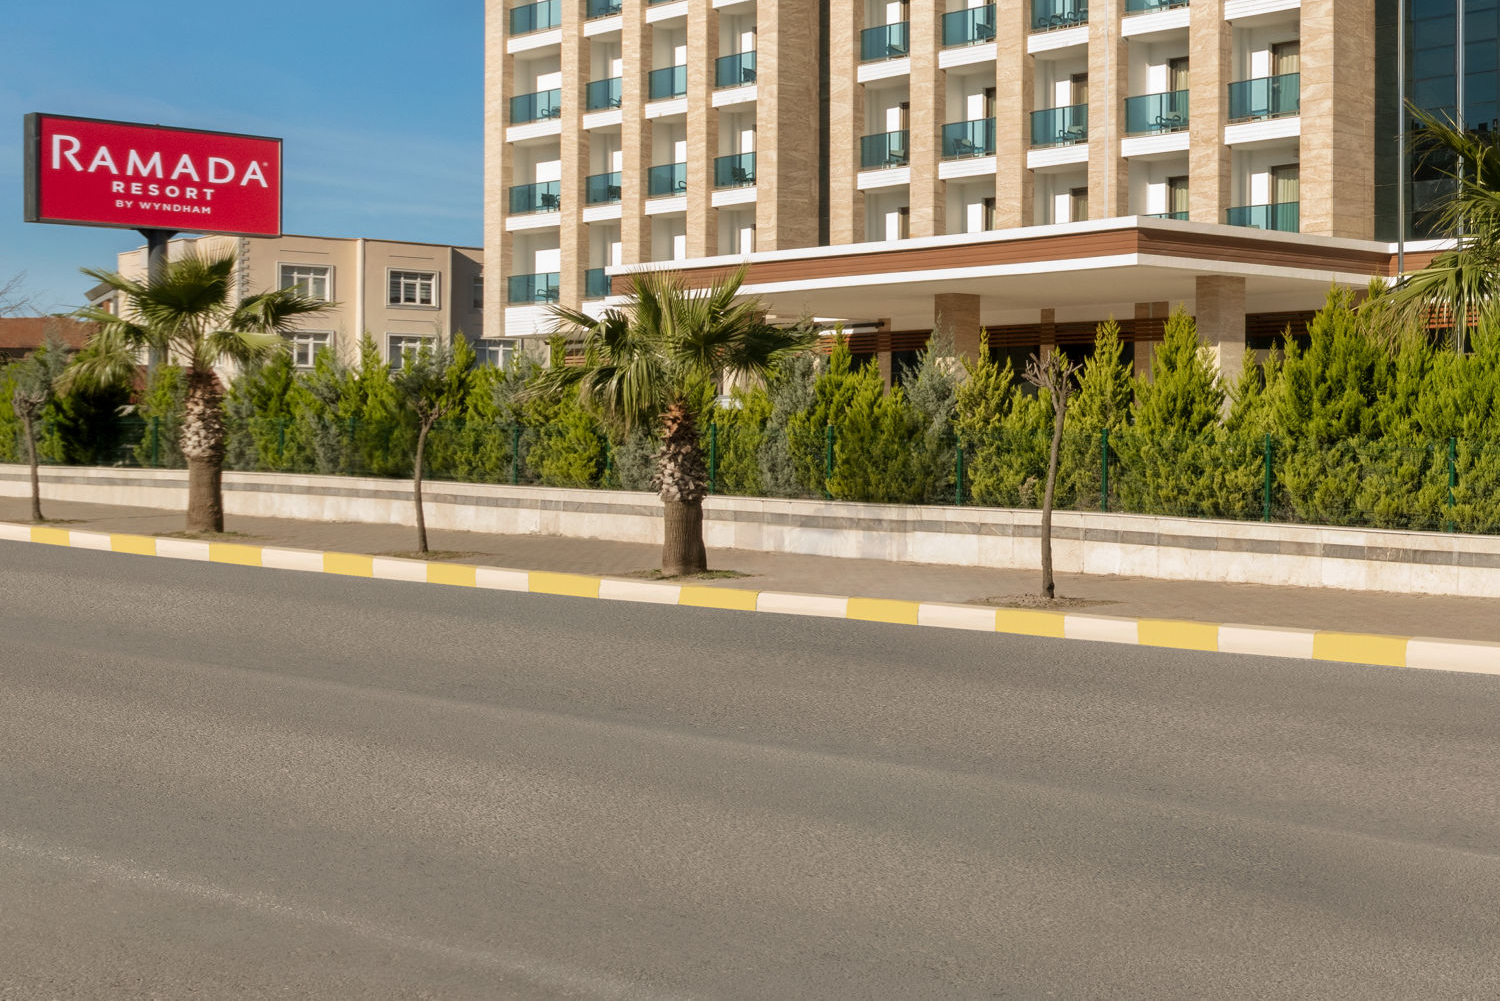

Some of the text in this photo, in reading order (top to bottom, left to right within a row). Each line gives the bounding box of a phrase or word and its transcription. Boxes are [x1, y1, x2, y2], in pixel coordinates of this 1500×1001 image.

[51, 133, 269, 188] RAMADA
[111, 180, 215, 201] RESORT
[115, 199, 211, 215] BY WYNDHAM
